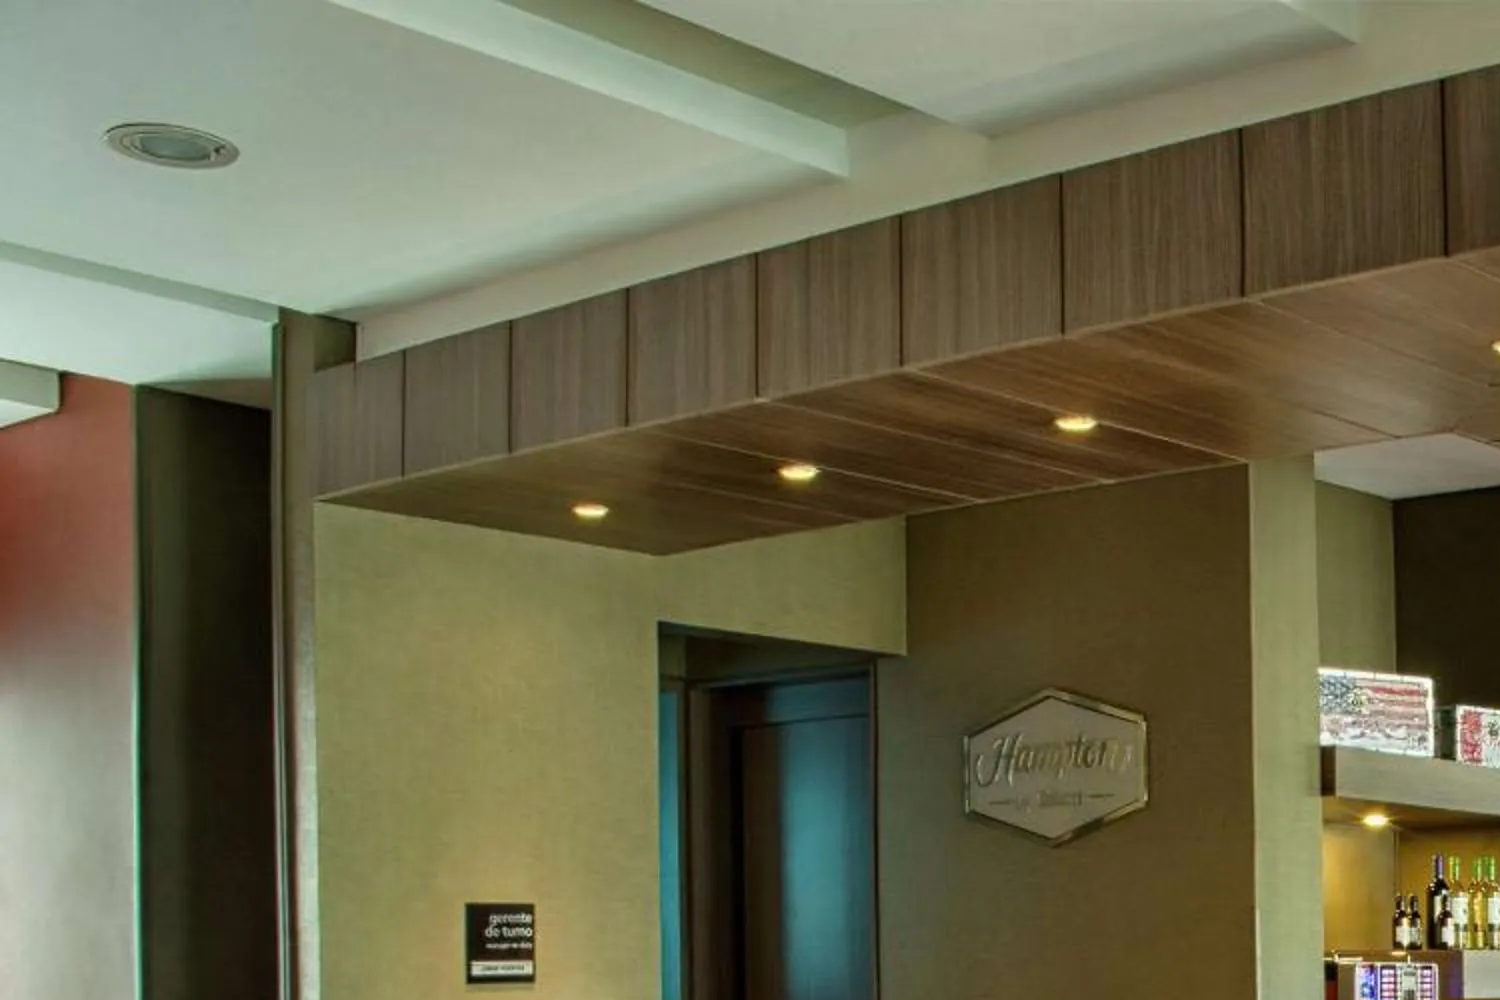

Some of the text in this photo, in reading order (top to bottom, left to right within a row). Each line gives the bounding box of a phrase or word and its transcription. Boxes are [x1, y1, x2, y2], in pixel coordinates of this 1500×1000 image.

[976, 733, 1132, 787] Hampton
[489, 912, 532, 925] gerente
[485, 925, 532, 938] de turno
